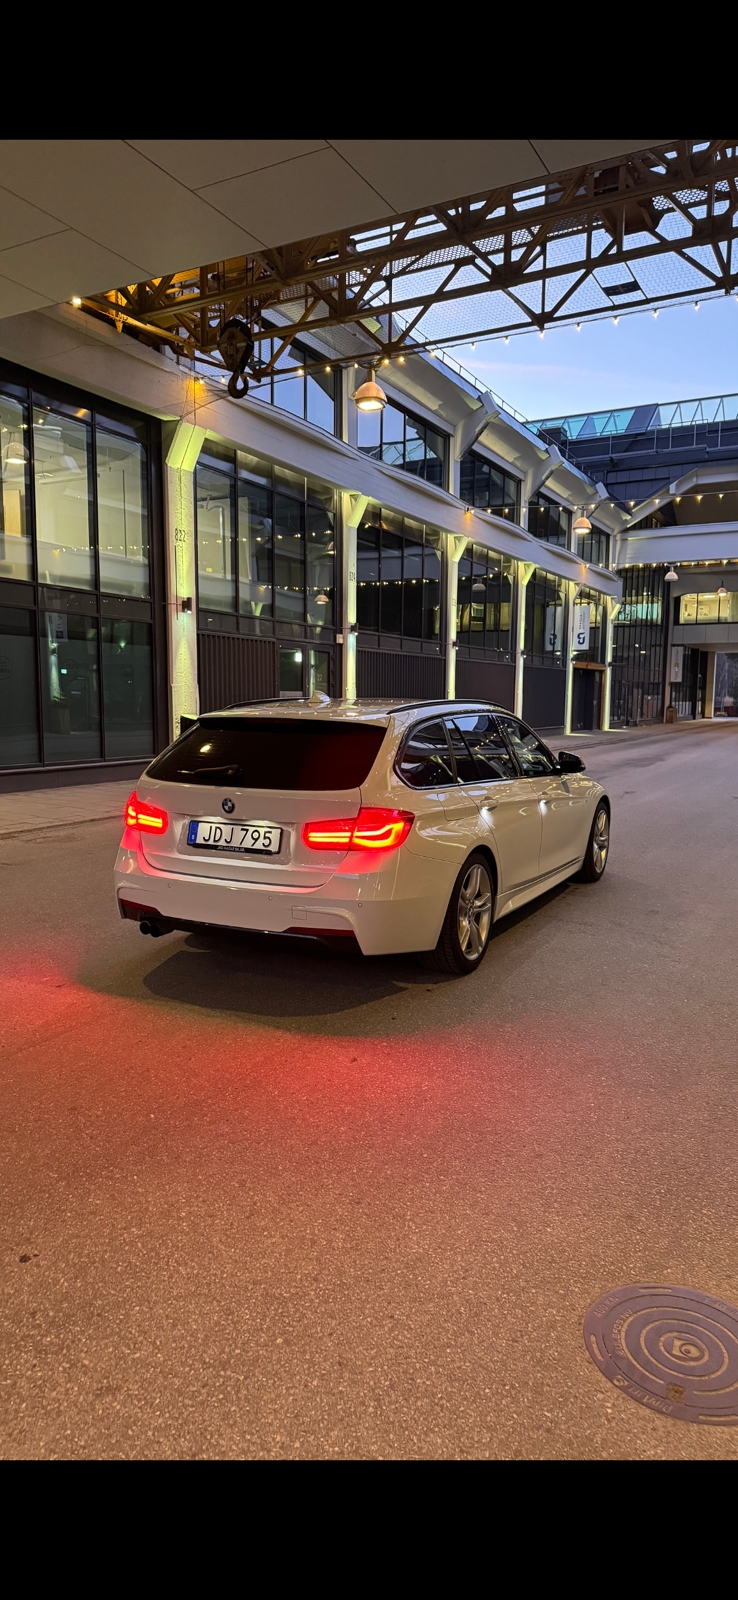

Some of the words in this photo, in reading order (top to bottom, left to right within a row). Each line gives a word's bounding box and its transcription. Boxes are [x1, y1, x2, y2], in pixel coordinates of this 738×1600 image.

[174, 527, 186, 543] 822
[202, 825, 234, 844] JDJ
[239, 828, 273, 848] 795
